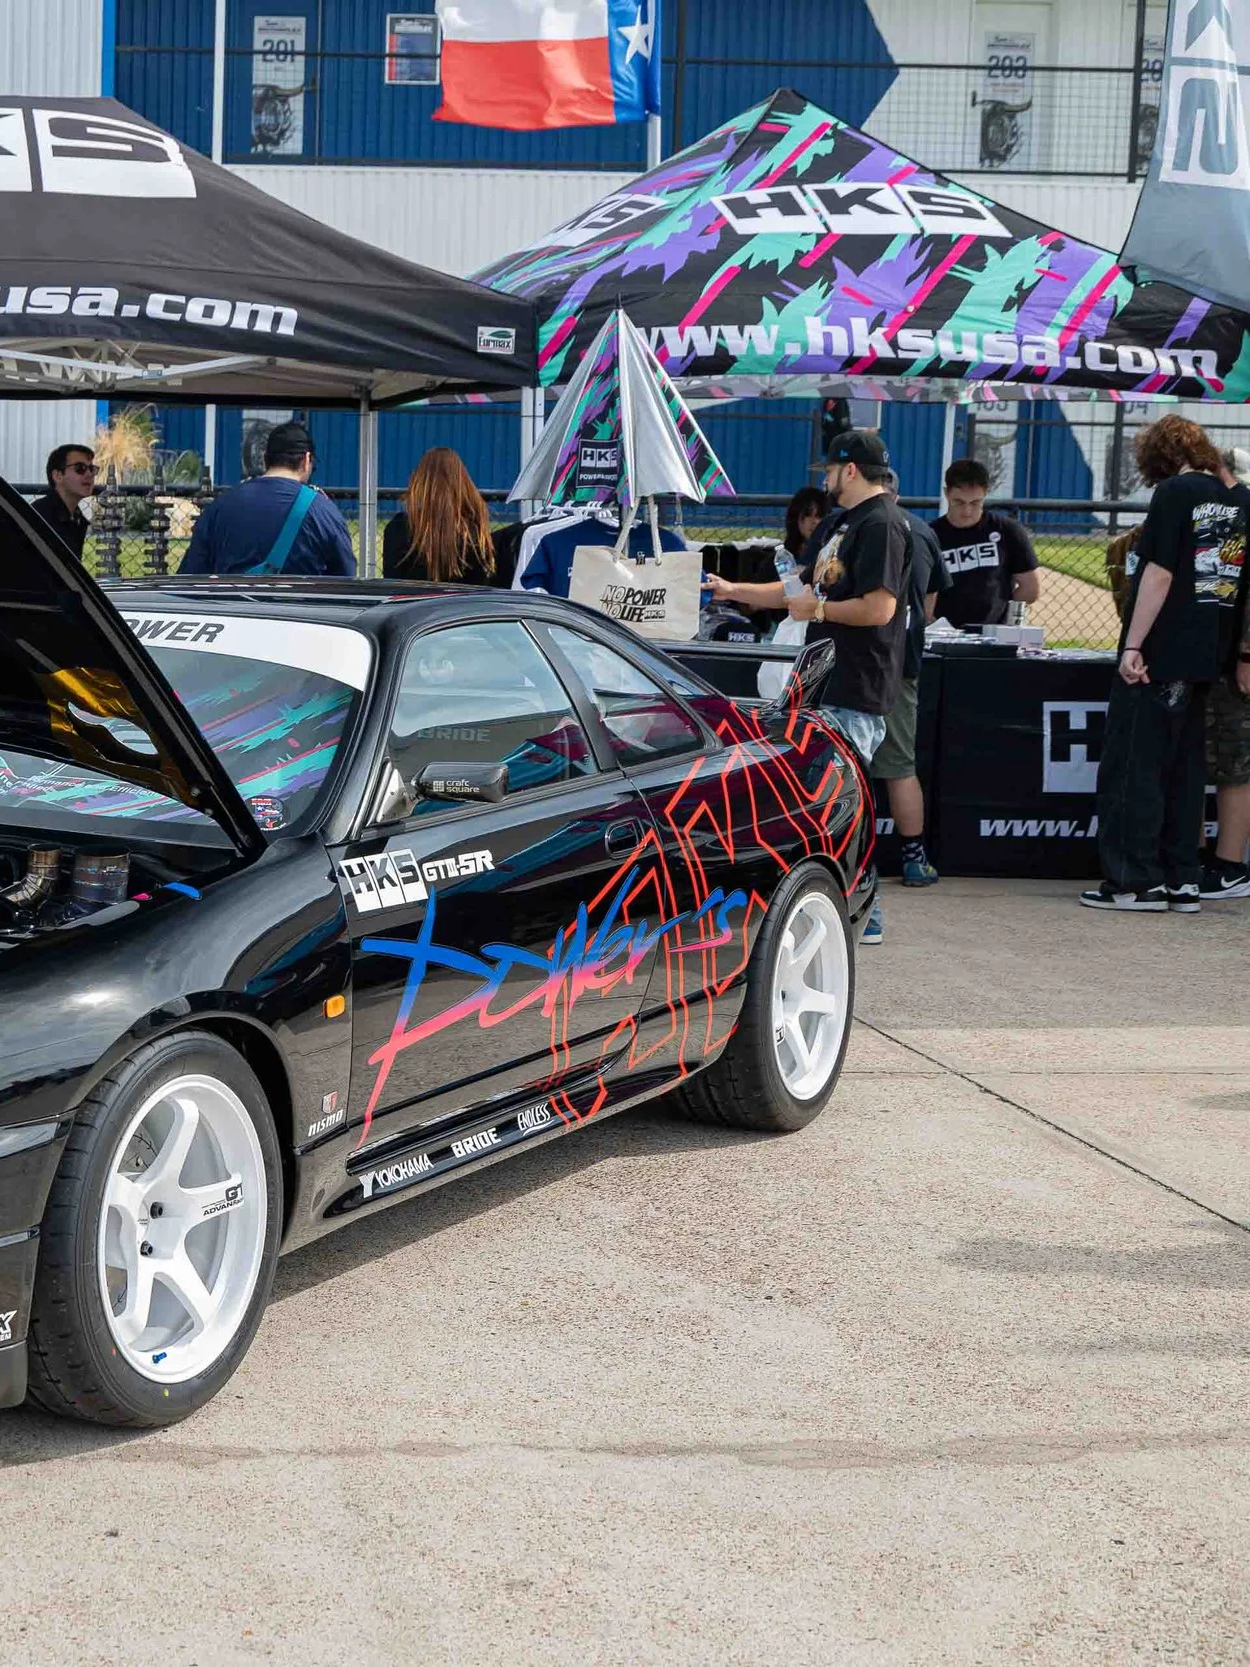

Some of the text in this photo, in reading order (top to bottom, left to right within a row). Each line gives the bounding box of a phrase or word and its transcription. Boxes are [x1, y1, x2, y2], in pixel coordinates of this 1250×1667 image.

[262, 40, 295, 63] 201
[987, 55, 1027, 79] 203
[711, 183, 1014, 238] HKS
[635, 317, 1220, 378] www.hksusa.com
[623, 587, 667, 606] POWER
[617, 605, 647, 622] LIFE
[123, 618, 225, 643] OWER
[728, 632, 755, 642] HKS
[446, 785, 480, 795] square
[338, 849, 429, 913] HKS
[516, 1102, 551, 1132] ENDLESS
[451, 1126, 502, 1159] BRIDE
[374, 1153, 434, 1189] YOKOHAMA
[203, 1201, 234, 1217] ADVAN
